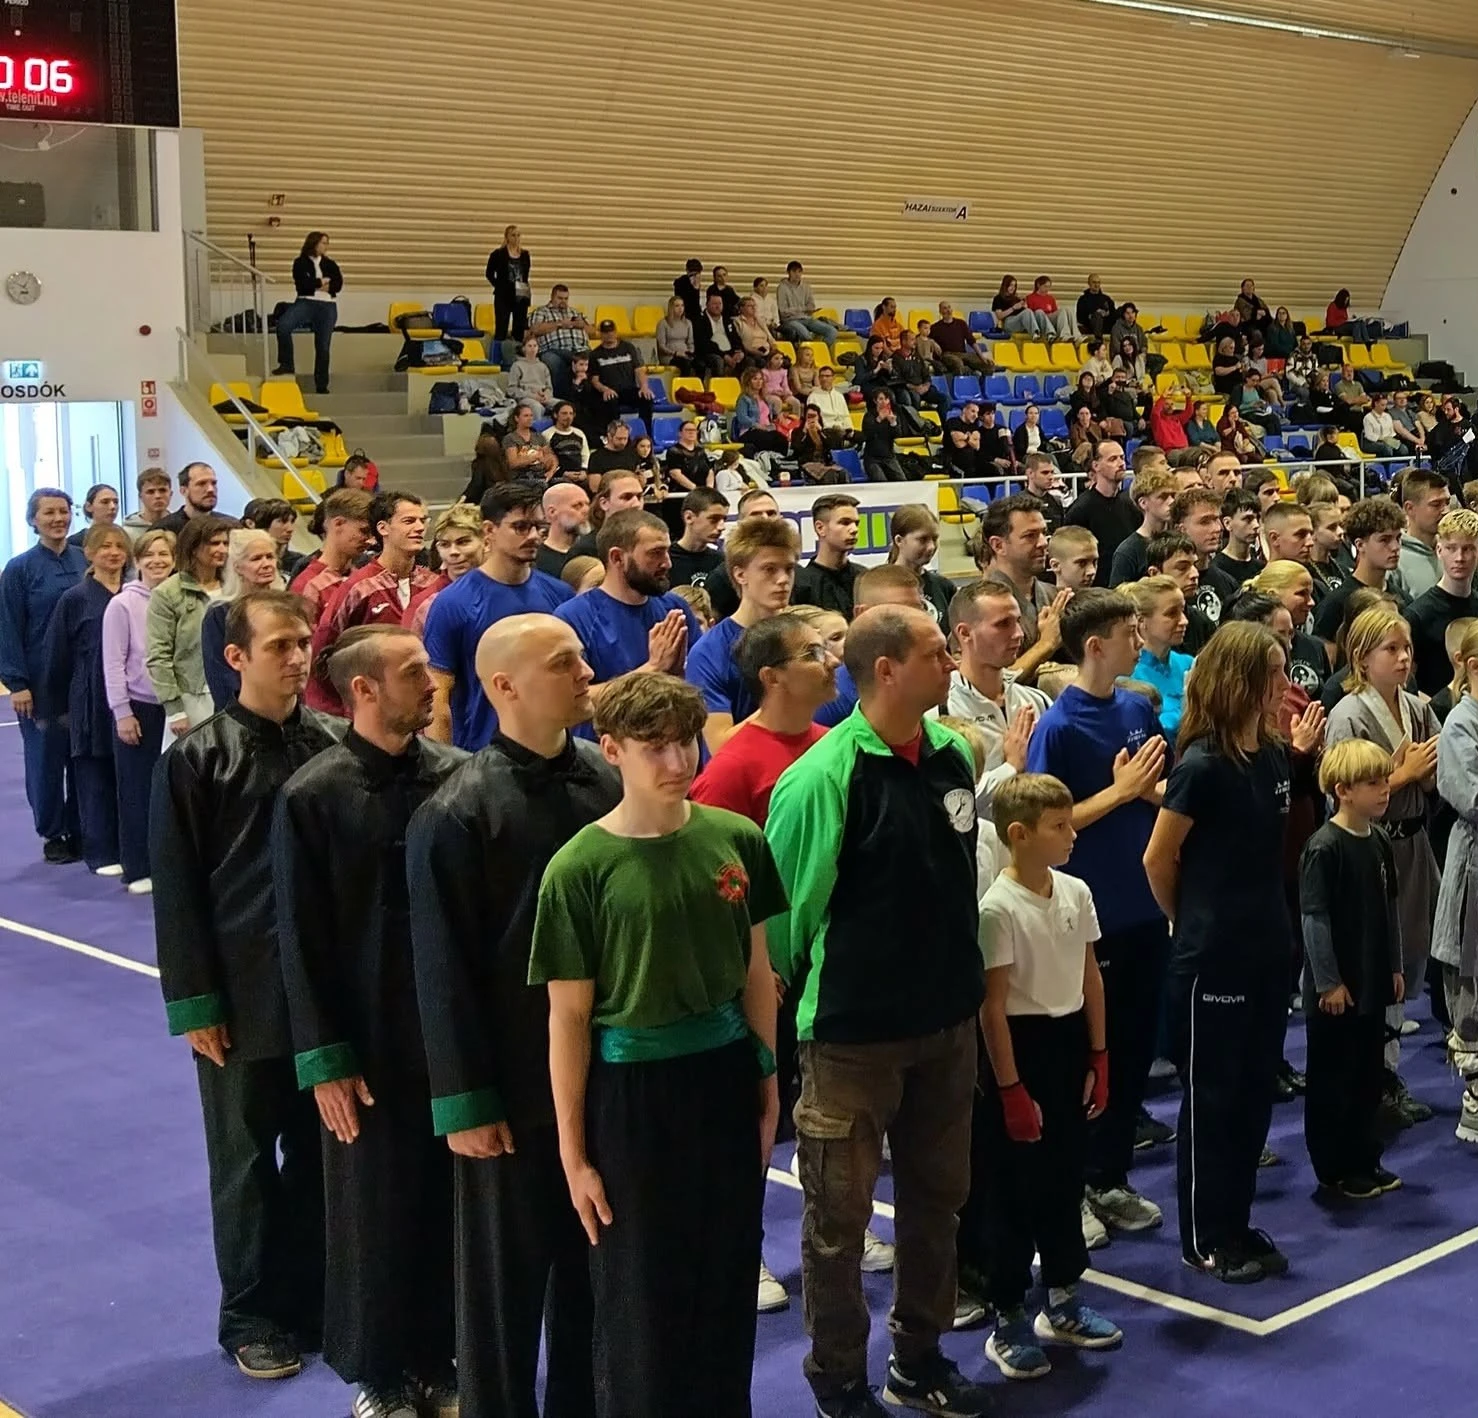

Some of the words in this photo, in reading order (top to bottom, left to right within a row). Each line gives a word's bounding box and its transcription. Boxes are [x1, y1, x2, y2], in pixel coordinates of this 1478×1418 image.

[24, 57, 73, 94] 06
[904, 203, 931, 213] HAZAI
[956, 206, 967, 220] A
[1202, 993, 1245, 1004] GIVOVA
